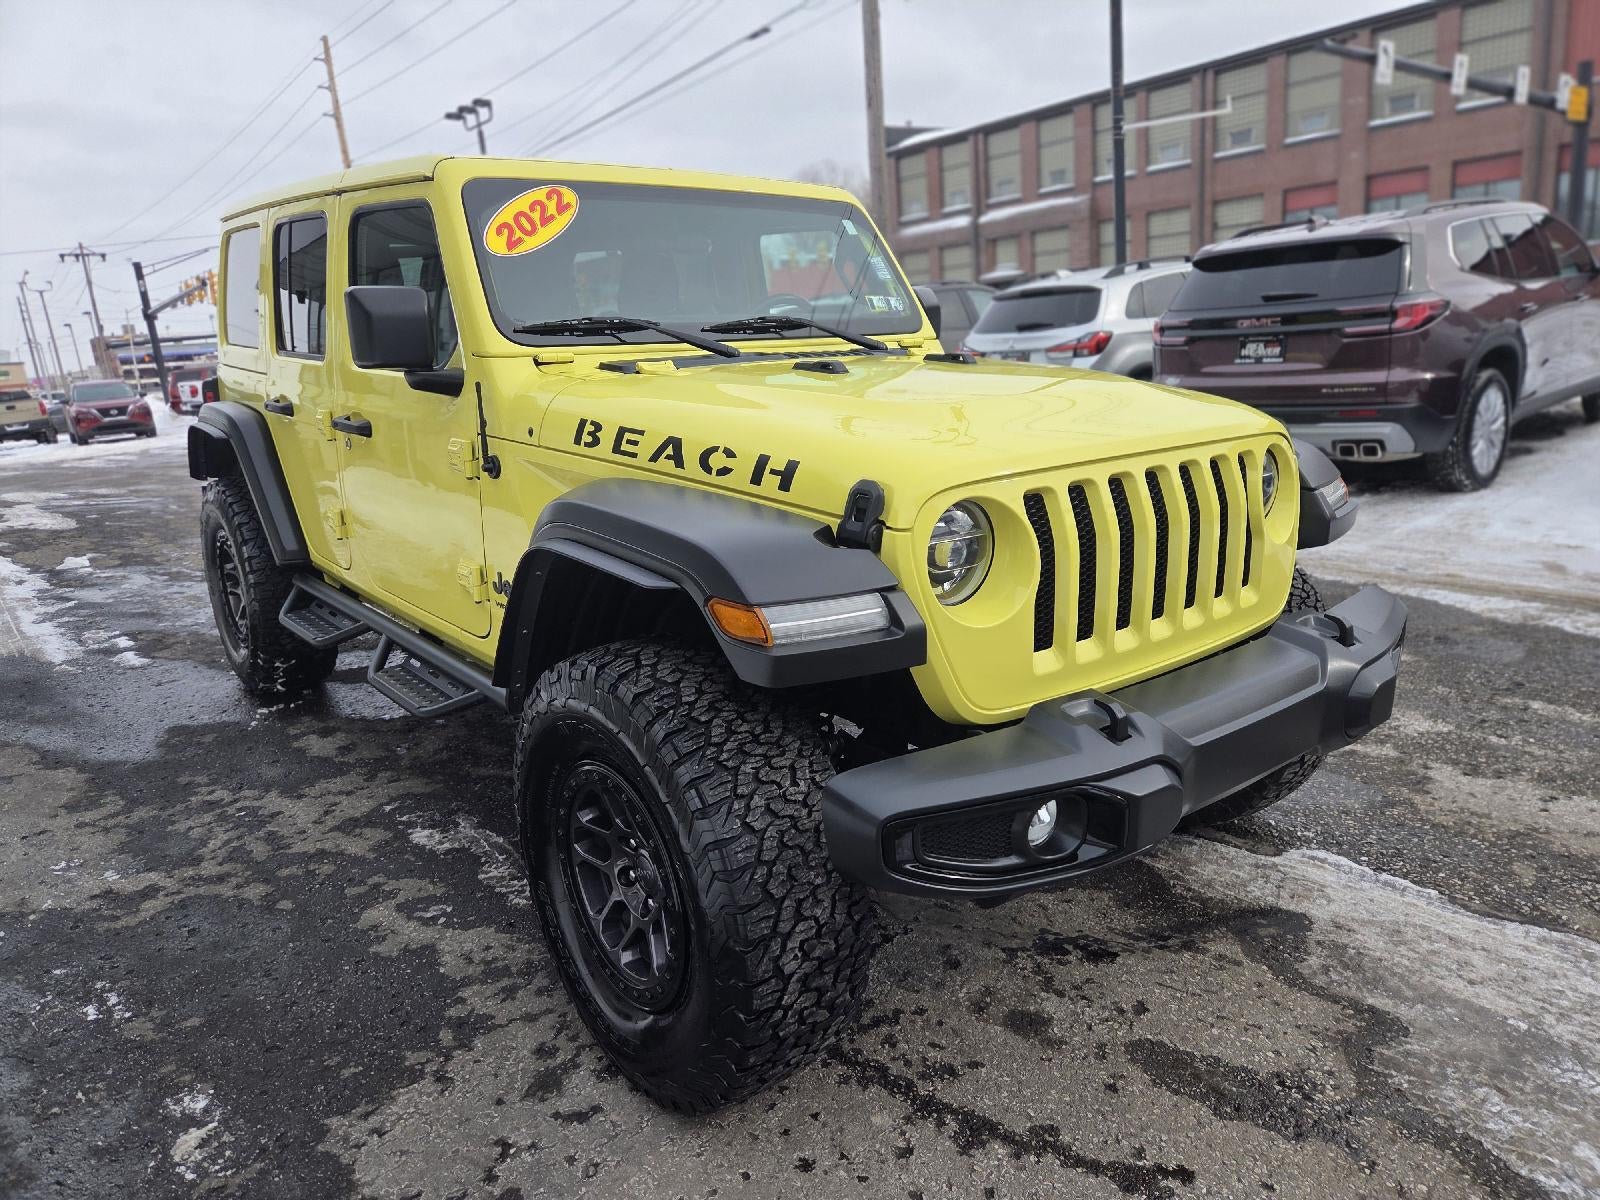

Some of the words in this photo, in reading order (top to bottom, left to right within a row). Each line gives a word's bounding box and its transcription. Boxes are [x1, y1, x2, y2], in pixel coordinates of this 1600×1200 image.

[495, 187, 573, 252] 2022
[1238, 317, 1281, 328] GMC
[573, 417, 801, 493] BEACH
[492, 571, 512, 599] Je
